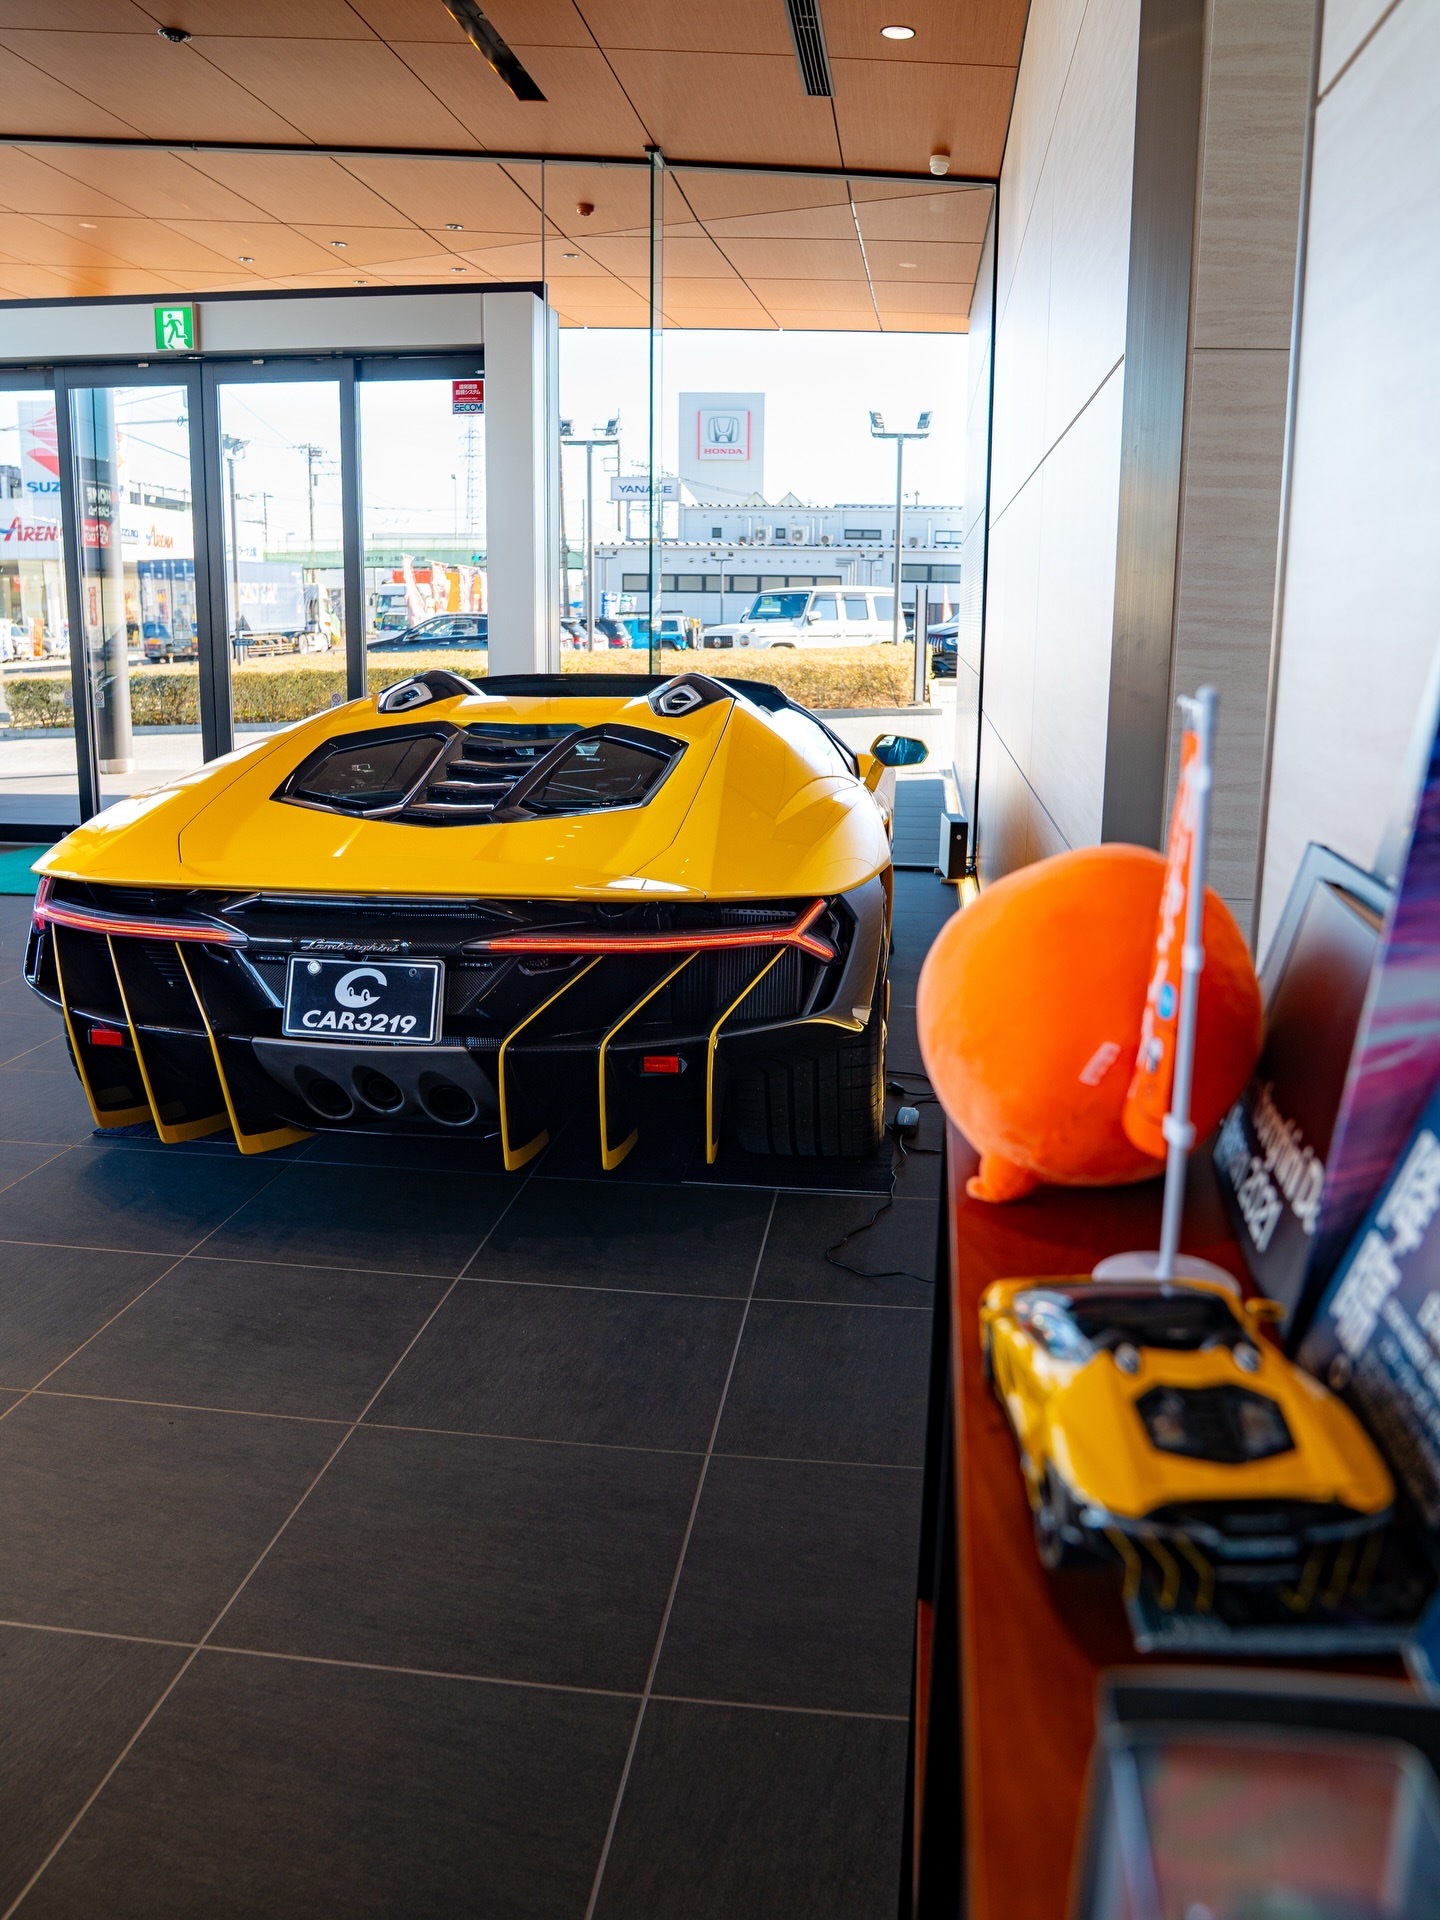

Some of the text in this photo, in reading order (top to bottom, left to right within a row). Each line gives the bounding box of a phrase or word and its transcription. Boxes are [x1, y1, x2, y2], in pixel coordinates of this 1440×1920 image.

[454, 403, 483, 412] SECOM
[703, 447, 744, 456] HONDA
[26, 480, 61, 493] SUZ
[618, 484, 673, 495] YANAE
[3, 516, 63, 542] AREN
[301, 938, 400, 953] Lamborghini
[302, 1009, 417, 1034] CAR3219
